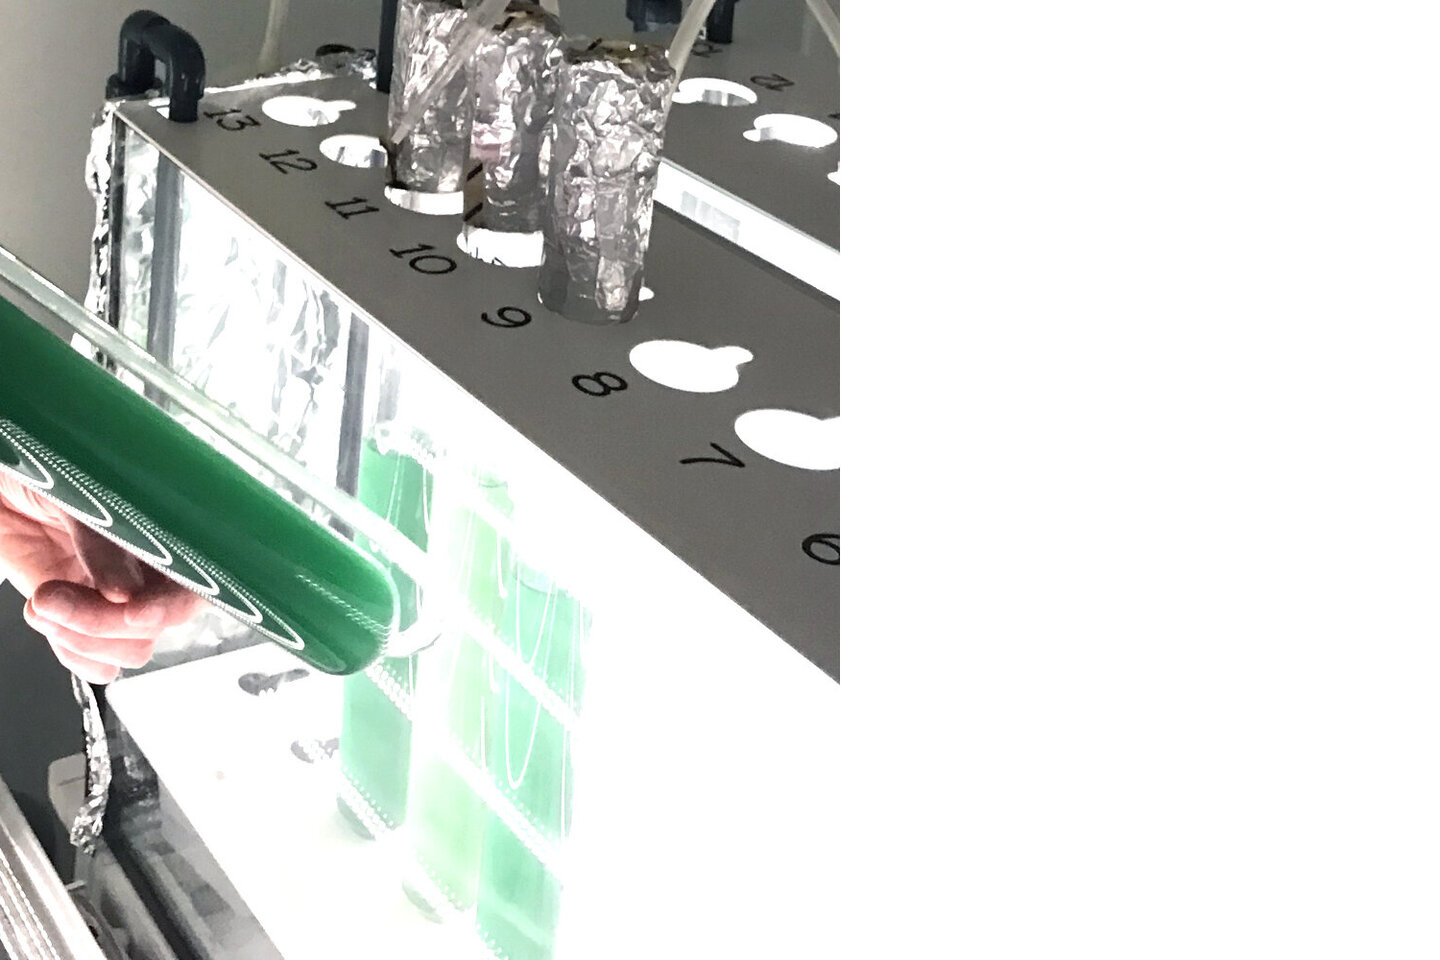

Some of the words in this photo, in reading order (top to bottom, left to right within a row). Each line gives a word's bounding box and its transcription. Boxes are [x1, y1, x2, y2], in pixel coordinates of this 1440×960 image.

[203, 108, 262, 132] 13
[259, 148, 318, 175] 12
[324, 196, 380, 220] 11
[389, 243, 458, 275] 10
[480, 306, 533, 329] 9
[571, 371, 629, 397] 8
[679, 442, 747, 468] 7
